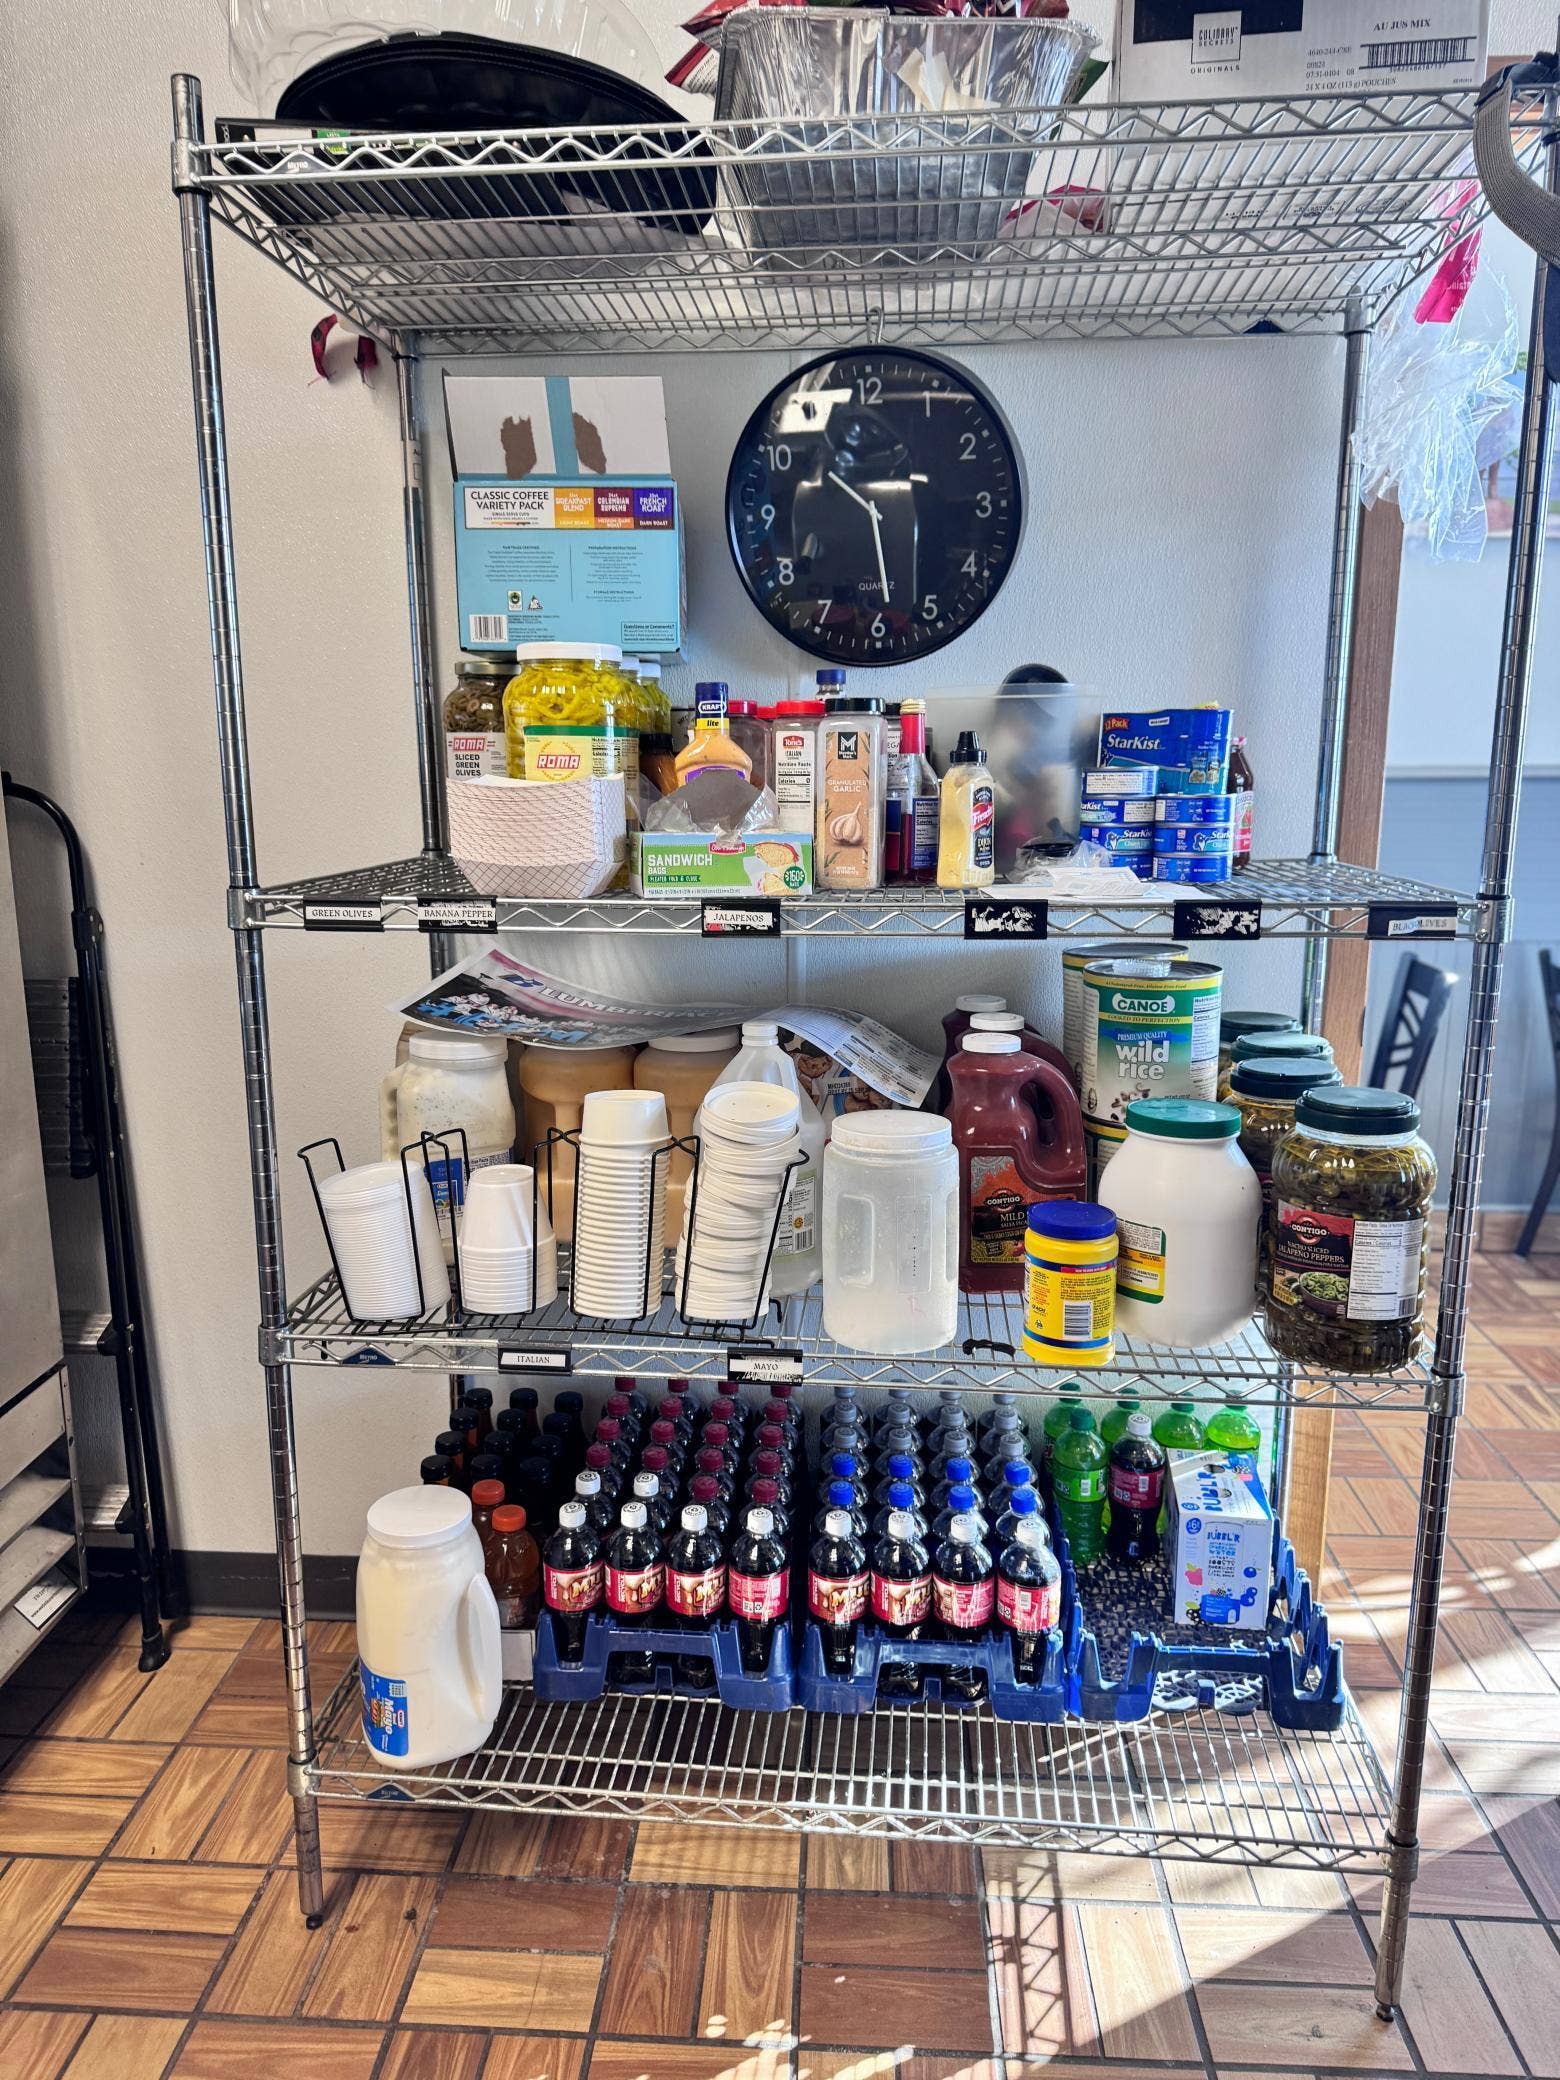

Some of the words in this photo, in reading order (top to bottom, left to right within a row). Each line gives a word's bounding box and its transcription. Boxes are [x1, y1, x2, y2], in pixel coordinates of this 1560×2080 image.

[1391, 21, 1408, 30] JUS
[1410, 19, 1431, 29] MIX
[1191, 65, 1240, 74] ORIGINALS
[856, 376, 883, 405] 12
[922, 391, 931, 418] 1
[959, 433, 977, 460] 2
[766, 443, 792, 471] 10
[471, 491, 511, 500] CLASSIC
[512, 491, 549, 500] COFFEE
[477, 501, 517, 510] VARIETY
[519, 502, 544, 510] PACK
[976, 491, 992, 518] 3
[761, 504, 776, 530] 9
[961, 552, 977, 577] 4
[778, 560, 795, 586] 8
[859, 582, 895, 591] QUARZ
[817, 599, 833, 624] 7
[922, 595, 938, 620] 5
[871, 612, 886, 637] 6
[1112, 718, 1129, 729] Pack
[454, 739, 486, 750] ROMA
[1107, 734, 1161, 750] StarKist
[538, 756, 580, 768] ROMA
[1081, 802, 1102, 810] arKist
[648, 854, 713, 866] SANDWICH
[788, 872, 800, 882] 160
[312, 909, 341, 918] GREEN
[342, 909, 373, 918] OLIVES
[424, 909, 460, 918] BANANA
[462, 910, 493, 918] PEPPER
[1118, 1000, 1168, 1012] CANOE
[1118, 1033, 1143, 1041] PREMIUM
[1143, 1032, 1168, 1040] QUALITY
[1116, 1041, 1170, 1063] wild
[1118, 1057, 1165, 1080] rice
[987, 1197, 1020, 1205] CONTIGO
[1001, 1212, 1025, 1221] MILD
[1291, 1225, 1327, 1236] CONTIGO
[1287, 1241, 1306, 1251] NACHO
[1311, 1253, 1345, 1263] PEPPERS
[1191, 1522, 1197, 1530] 6
[384, 1698, 394, 1735] Mayo
